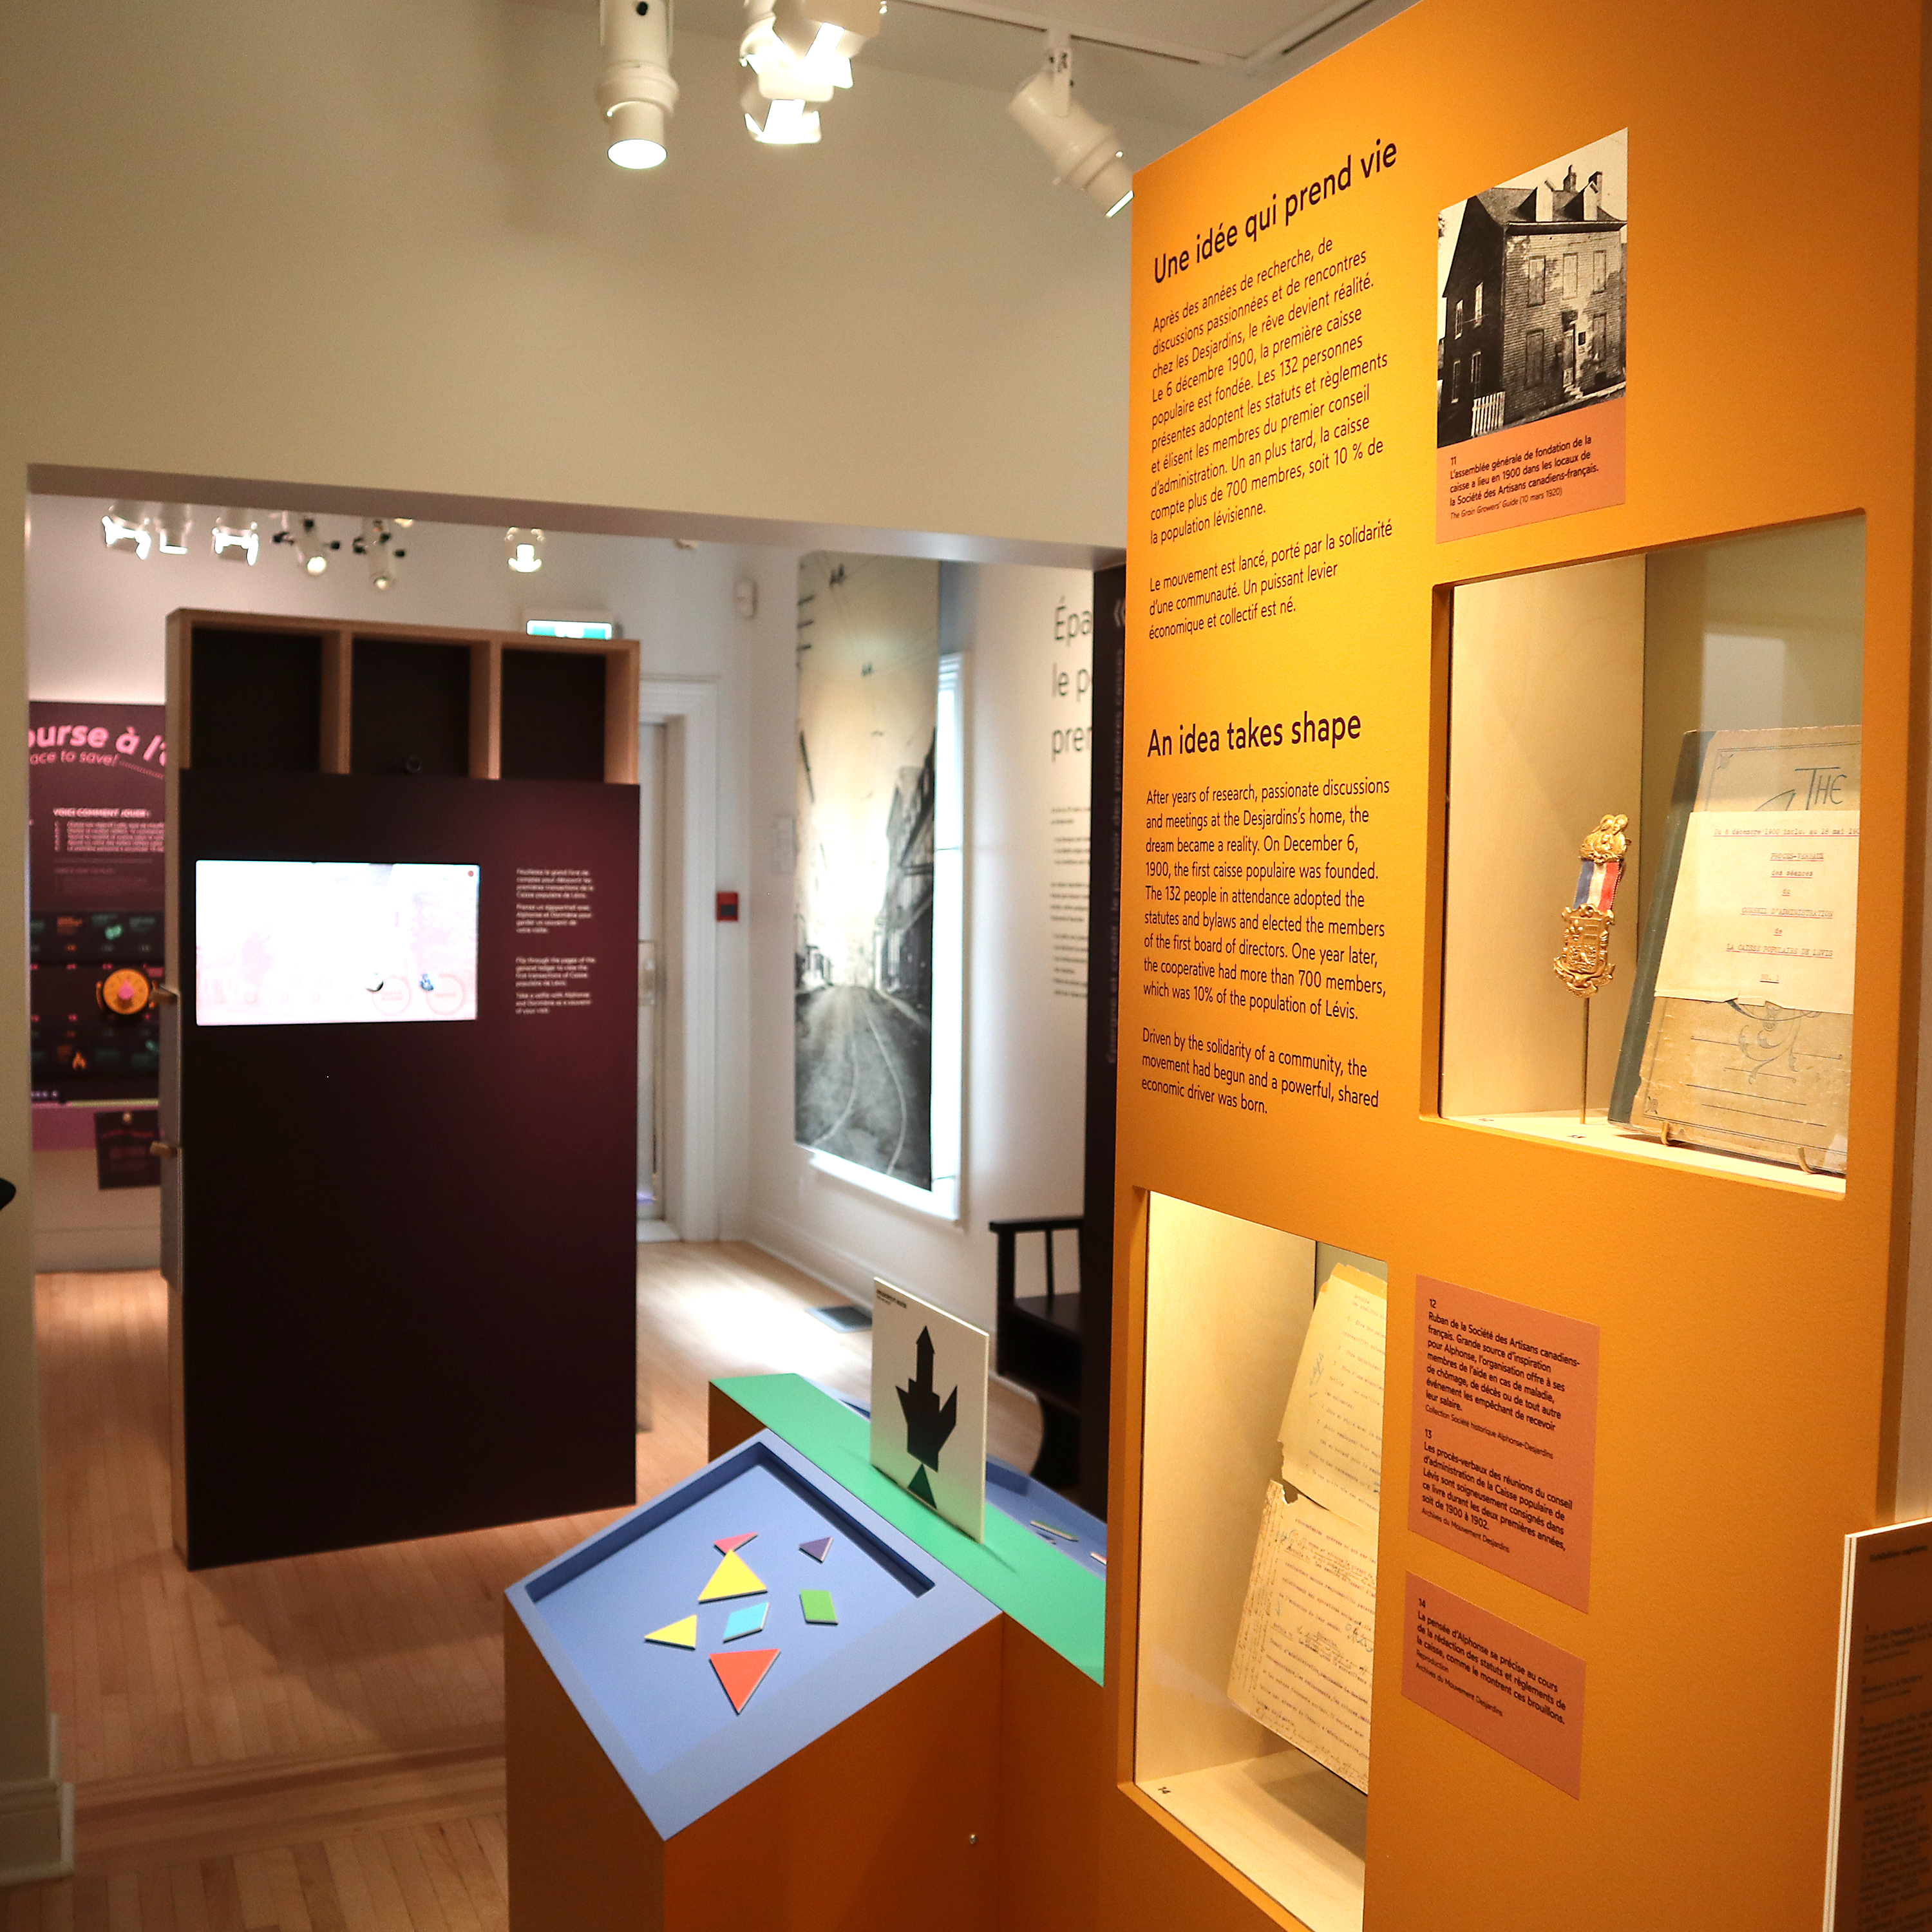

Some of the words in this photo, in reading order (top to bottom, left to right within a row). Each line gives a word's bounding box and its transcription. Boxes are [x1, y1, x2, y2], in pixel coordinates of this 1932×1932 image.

[1154, 249, 1189, 283] Une
[1196, 222, 1238, 263] idée
[1244, 193, 1276, 242] qui
[1285, 153, 1351, 227] prend
[1359, 138, 1397, 178] vie
[1152, 309, 1179, 332] Après
[1182, 301, 1198, 318] des
[1202, 283, 1236, 309] années
[1240, 274, 1253, 291] de
[1256, 249, 1314, 284] recherche,
[1318, 237, 1332, 255] de
[1152, 323, 1204, 355] discussions
[1206, 294, 1268, 336] passionnées
[1271, 285, 1282, 303] et
[1285, 278, 1300, 296] de
[1304, 250, 1367, 289] rencontres
[1152, 361, 1173, 379] chez
[1176, 354, 1189, 368] les
[1191, 331, 1245, 363] Desjardins,
[1249, 322, 1258, 338] le
[1261, 314, 1284, 333] rêve
[1287, 290, 1329, 321] devient
[1334, 272, 1374, 302] réalité.
[1152, 388, 1163, 402] Le
[1166, 381, 1172, 397] 6
[1175, 364, 1224, 393] décembre
[1227, 347, 1256, 372] 1900,
[1260, 343, 1269, 359] la
[1273, 324, 1323, 358] première
[1326, 308, 1362, 332] caisse
[1449, 482, 1470, 493] caisse
[1477, 476, 1490, 486] lieu
[1491, 474, 1501, 483] en
[1502, 466, 1520, 480] 1900
[1522, 464, 1540, 475] dans
[1541, 460, 1552, 470] les
[1554, 454, 1579, 467] locaux
[1580, 450, 1591, 460] de
[1450, 462, 1490, 480] L'assemblée
[1491, 453, 1522, 471] générale
[1523, 450, 1533, 460] de
[1535, 442, 1571, 458] fondation
[1572, 437, 1583, 448] de
[1584, 435, 1591, 445] la
[1450, 457, 1457, 465] 11
[1449, 497, 1455, 506] la
[1457, 490, 1482, 505] Société
[1483, 488, 1496, 498] des
[1497, 481, 1526, 495] Artisans
[1528, 464, 1599, 488] canadiens-français.
[1461, 509, 1475, 517] Grain
[1502, 497, 1519, 508] Guide
[1530, 492, 1544, 500] mars
[1052, 662, 1070, 697] le
[115, 726, 140, 755] à
[1146, 728, 1172, 757] An
[1179, 723, 1219, 754] idea
[1226, 716, 1283, 750] takes
[1291, 710, 1361, 749] shape
[61, 750, 77, 763] to
[79, 751, 120, 767] save!
[1146, 788, 1170, 804] After
[1171, 791, 1197, 808] years
[1199, 786, 1209, 802] of
[1212, 783, 1258, 802] research,
[1261, 781, 1319, 803] passionate
[1322, 777, 1390, 796] discussions
[1795, 767, 1848, 811] THE
[1146, 812, 1162, 829] and
[1165, 811, 1208, 831] meetings
[1211, 812, 1220, 827] at
[1223, 810, 1240, 826] the
[1243, 807, 1305, 830] Desjardins's
[1309, 806, 1345, 826] home,
[1349, 805, 1369, 823] the
[1145, 837, 1174, 853] dream
[1177, 837, 1215, 852] became
[1217, 840, 1224, 852] a
[1226, 835, 1260, 856] reality.
[1263, 835, 1280, 851] On
[1283, 833, 1343, 851] December
[1347, 833, 1358, 854] 6,
[1145, 861, 1171, 879] 1900,
[1173, 861, 1189, 876] the
[1191, 860, 1210, 877] first
[1213, 860, 1243, 878] caisse
[1245, 860, 1296, 882] populaire
[1298, 866, 1321, 878] was
[1324, 861, 1378, 880] founded.
[1429, 1299, 1436, 1309] 12
[1427, 1324, 1455, 1341] français.
[1455, 1333, 1481, 1350] Grande
[1482, 1344, 1506, 1358] source
[1506, 1350, 1551, 1373] d'inspiration
[1428, 1311, 1449, 1325] Ruban
[1450, 1318, 1459, 1329] de
[1460, 1321, 1466, 1332] la
[1468, 1323, 1493, 1340] Société
[1494, 1332, 1508, 1345] des
[1509, 1337, 1539, 1354] Artisans
[1539, 1349, 1580, 1367] canadiens-
[1425, 1428, 1432, 1439] 13
[1423, 1441, 1435, 1454] Les
[1436, 1448, 1488, 1475] procès-verbaux
[1488, 1468, 1501, 1481] des
[1502, 1475, 1533, 1494] réunions
[1535, 1487, 1545, 1499] du
[1546, 1493, 1573, 1510] conseil
[1417, 1610, 1426, 1622] La
[1426, 1616, 1450, 1634] pensée
[1490, 1650, 1498, 1661] se
[1499, 1656, 1525, 1675] précise
[1526, 1670, 1536, 1681] au
[1537, 1676, 1558, 1692] cours
